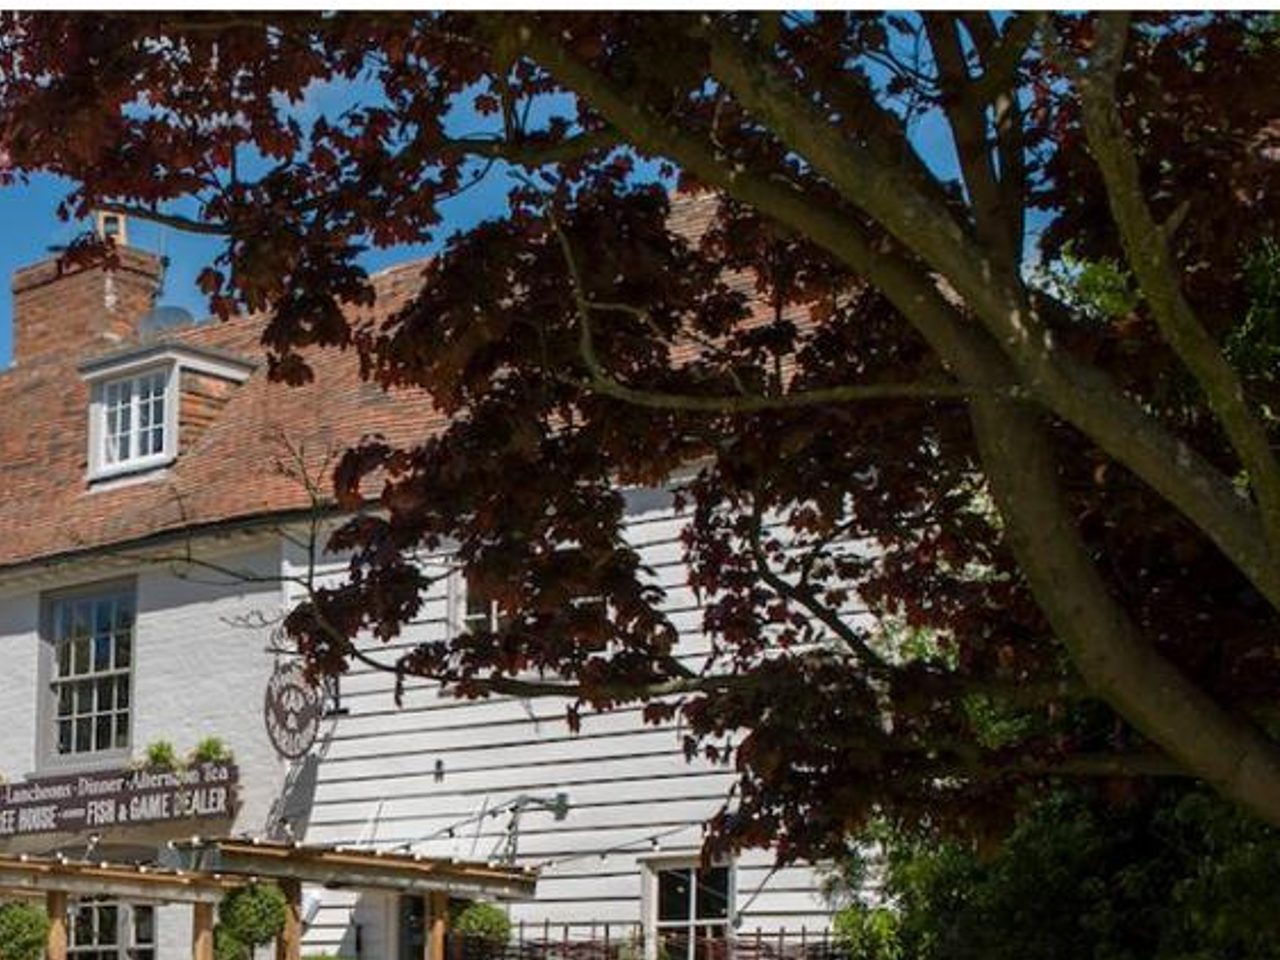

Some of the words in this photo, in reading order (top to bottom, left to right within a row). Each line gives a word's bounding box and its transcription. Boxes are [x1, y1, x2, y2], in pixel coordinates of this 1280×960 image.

[6, 783, 72, 804] Luncheons
[77, 777, 125, 797] Dinner
[202, 762, 229, 782] Tea
[19, 805, 58, 832] HOUSE
[86, 799, 116, 825] FISH
[130, 793, 172, 821] GAME
